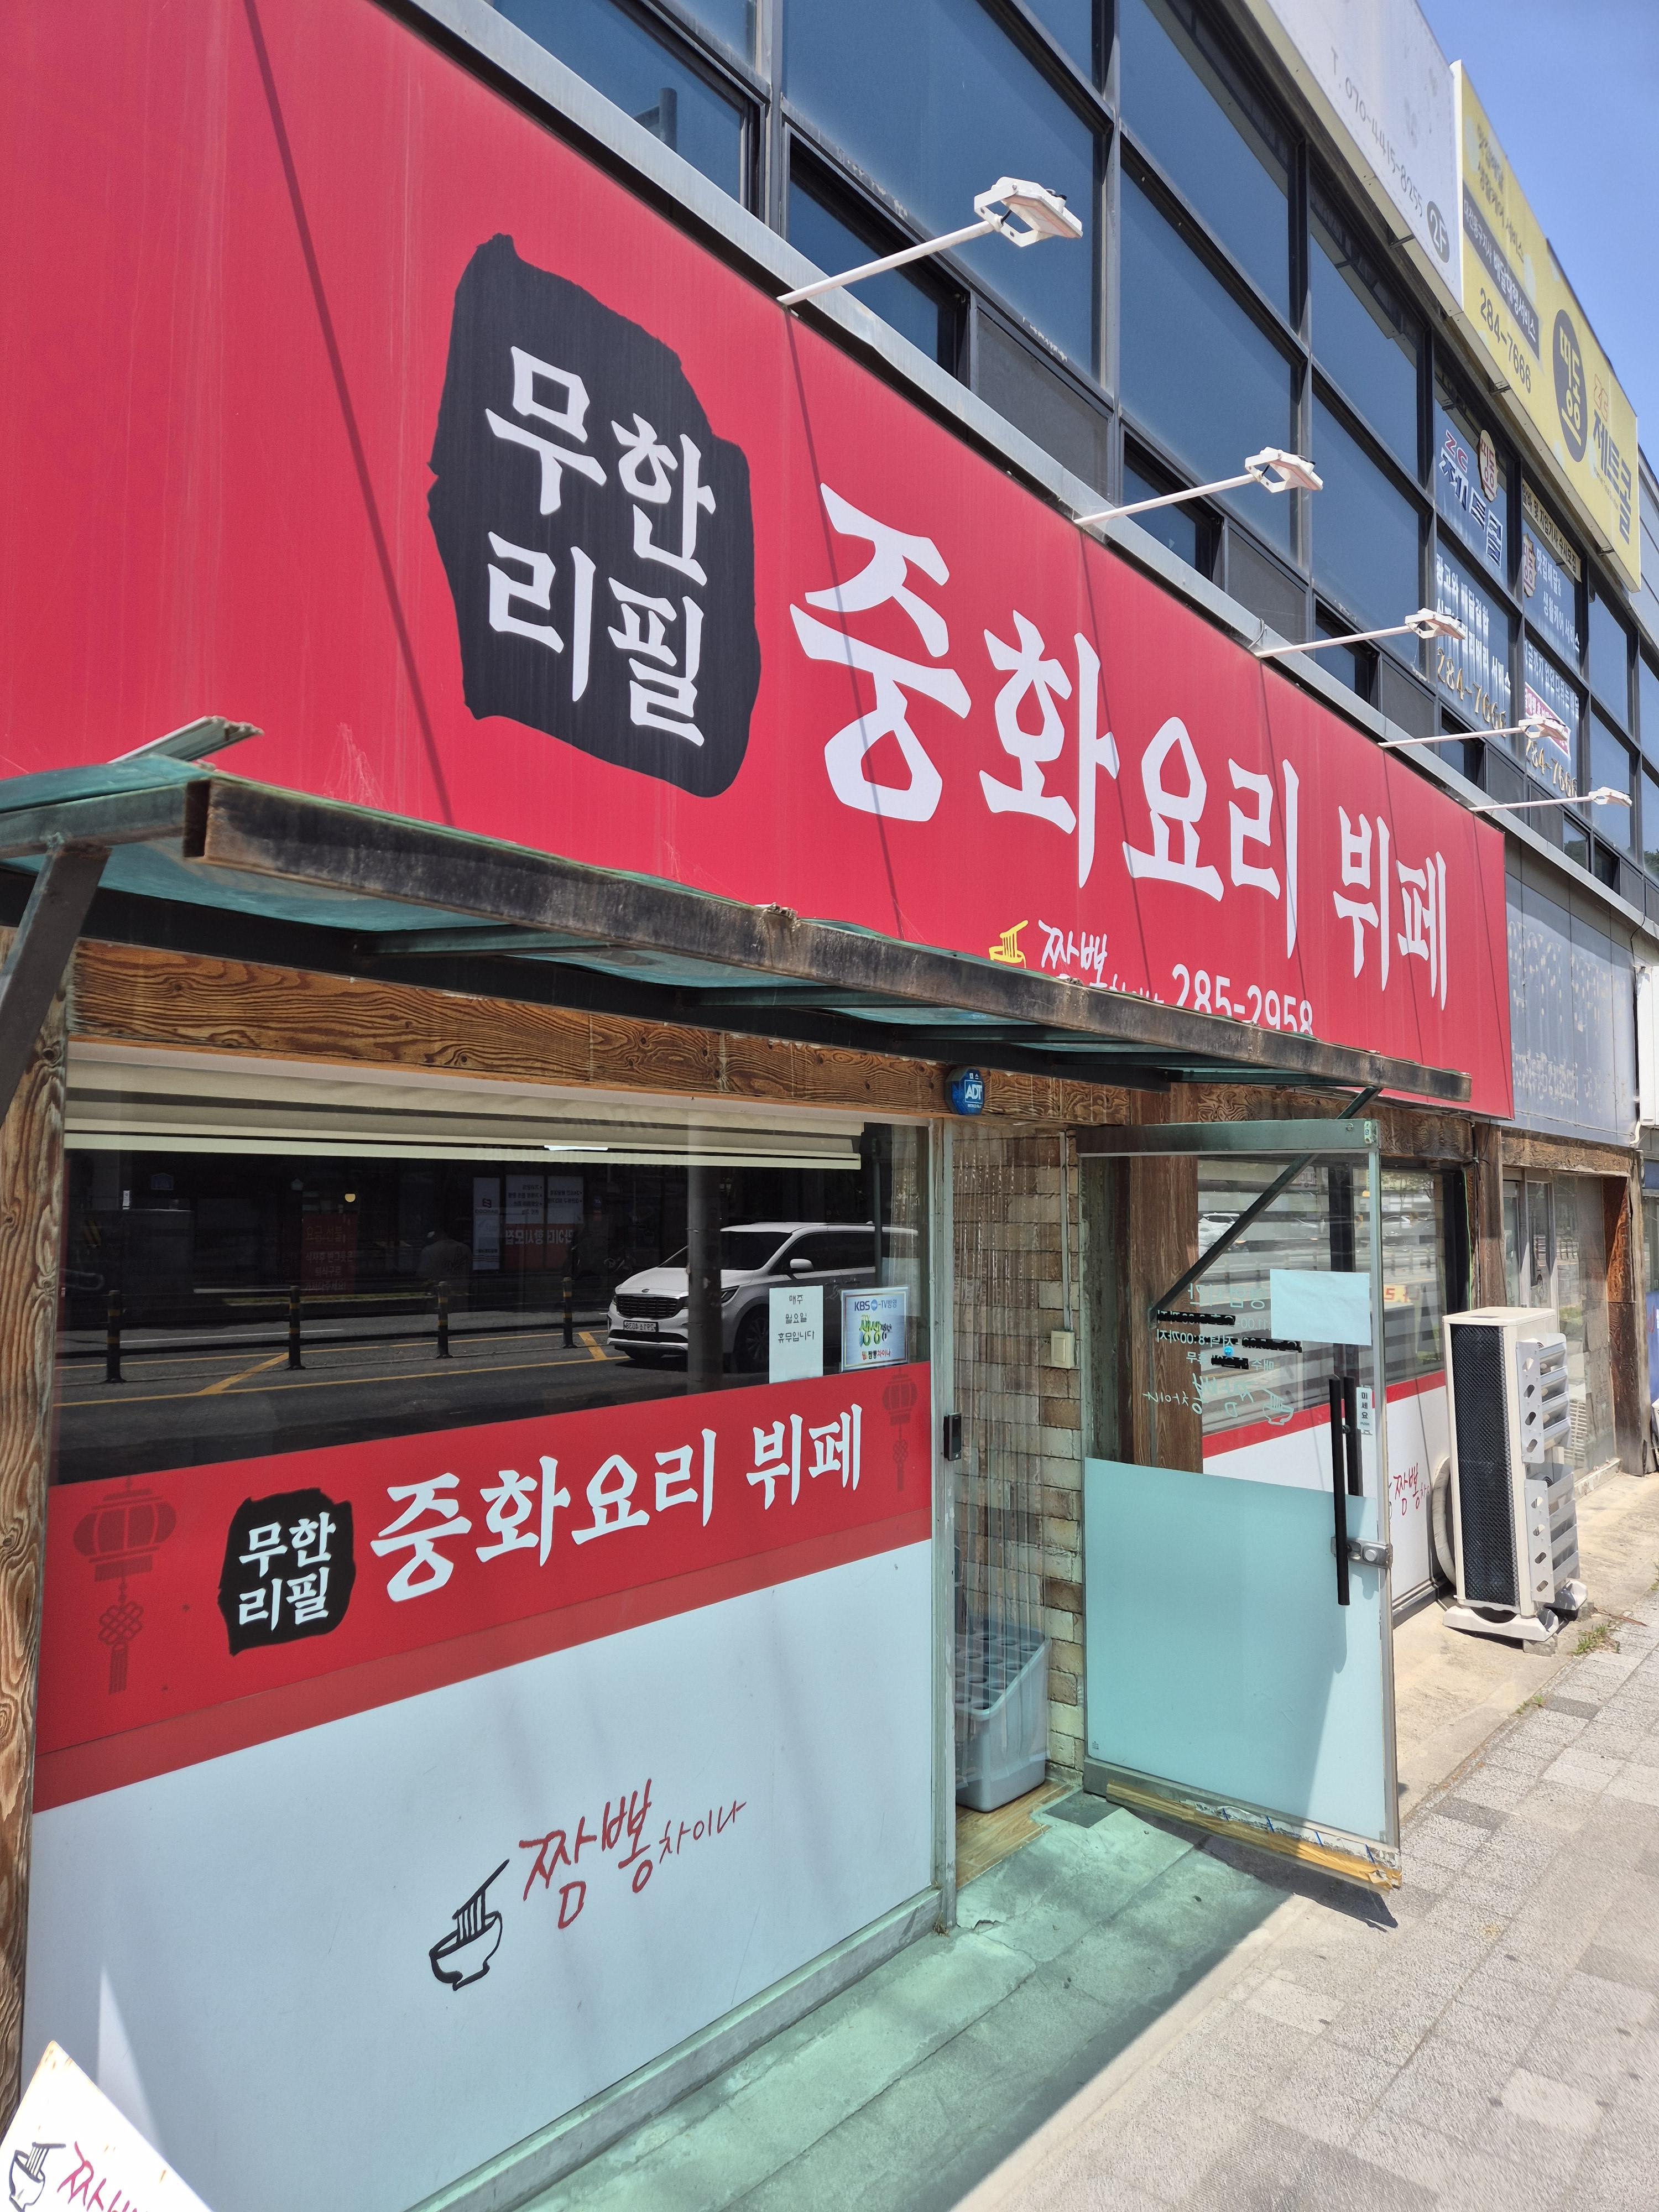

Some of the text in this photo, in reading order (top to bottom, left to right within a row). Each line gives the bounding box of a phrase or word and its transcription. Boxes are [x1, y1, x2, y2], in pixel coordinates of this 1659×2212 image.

[1345, 77, 1422, 217] 070-4415-8255
[1429, 203, 1448, 262] 2F
[1506, 218, 1524, 264] 서비스
[1493, 250, 1536, 343] 배달대행서비스
[1480, 287, 1531, 394] 284-7666
[1559, 325, 1581, 447] 띵동
[485, 346, 716, 586] 무한
[1445, 430, 1468, 473] ZC
[1480, 437, 1495, 498] 띵동
[1593, 409, 1631, 545] 제트콜
[1438, 446, 1504, 569] 제트콜
[1559, 538, 1577, 572] 수시모집
[487, 531, 704, 746] 리필
[1543, 590, 1580, 653] 생활케어 서비스
[1437, 647, 1506, 738] 284-7666
[1492, 655, 1511, 694] 서비스
[790, 483, 1446, 1010] 중화요리 뷔페
[1172, 963, 1313, 1035] 285-2958
[965, 1084, 983, 1100] ADT
[785, 1313, 807, 1324] 일요일
[789, 1295, 804, 1305] 매주
[854, 1300, 870, 1311] KBS
[778, 1330, 815, 1344] 휴무입니다
[370, 1404, 862, 1603] 중화요리 뷔페
[1393, 1462, 1420, 1516] 짬뽕
[239, 1511, 336, 1577] 무한
[239, 1567, 330, 1630] 리필
[519, 1778, 747, 1929] 짬뽕 차이나
